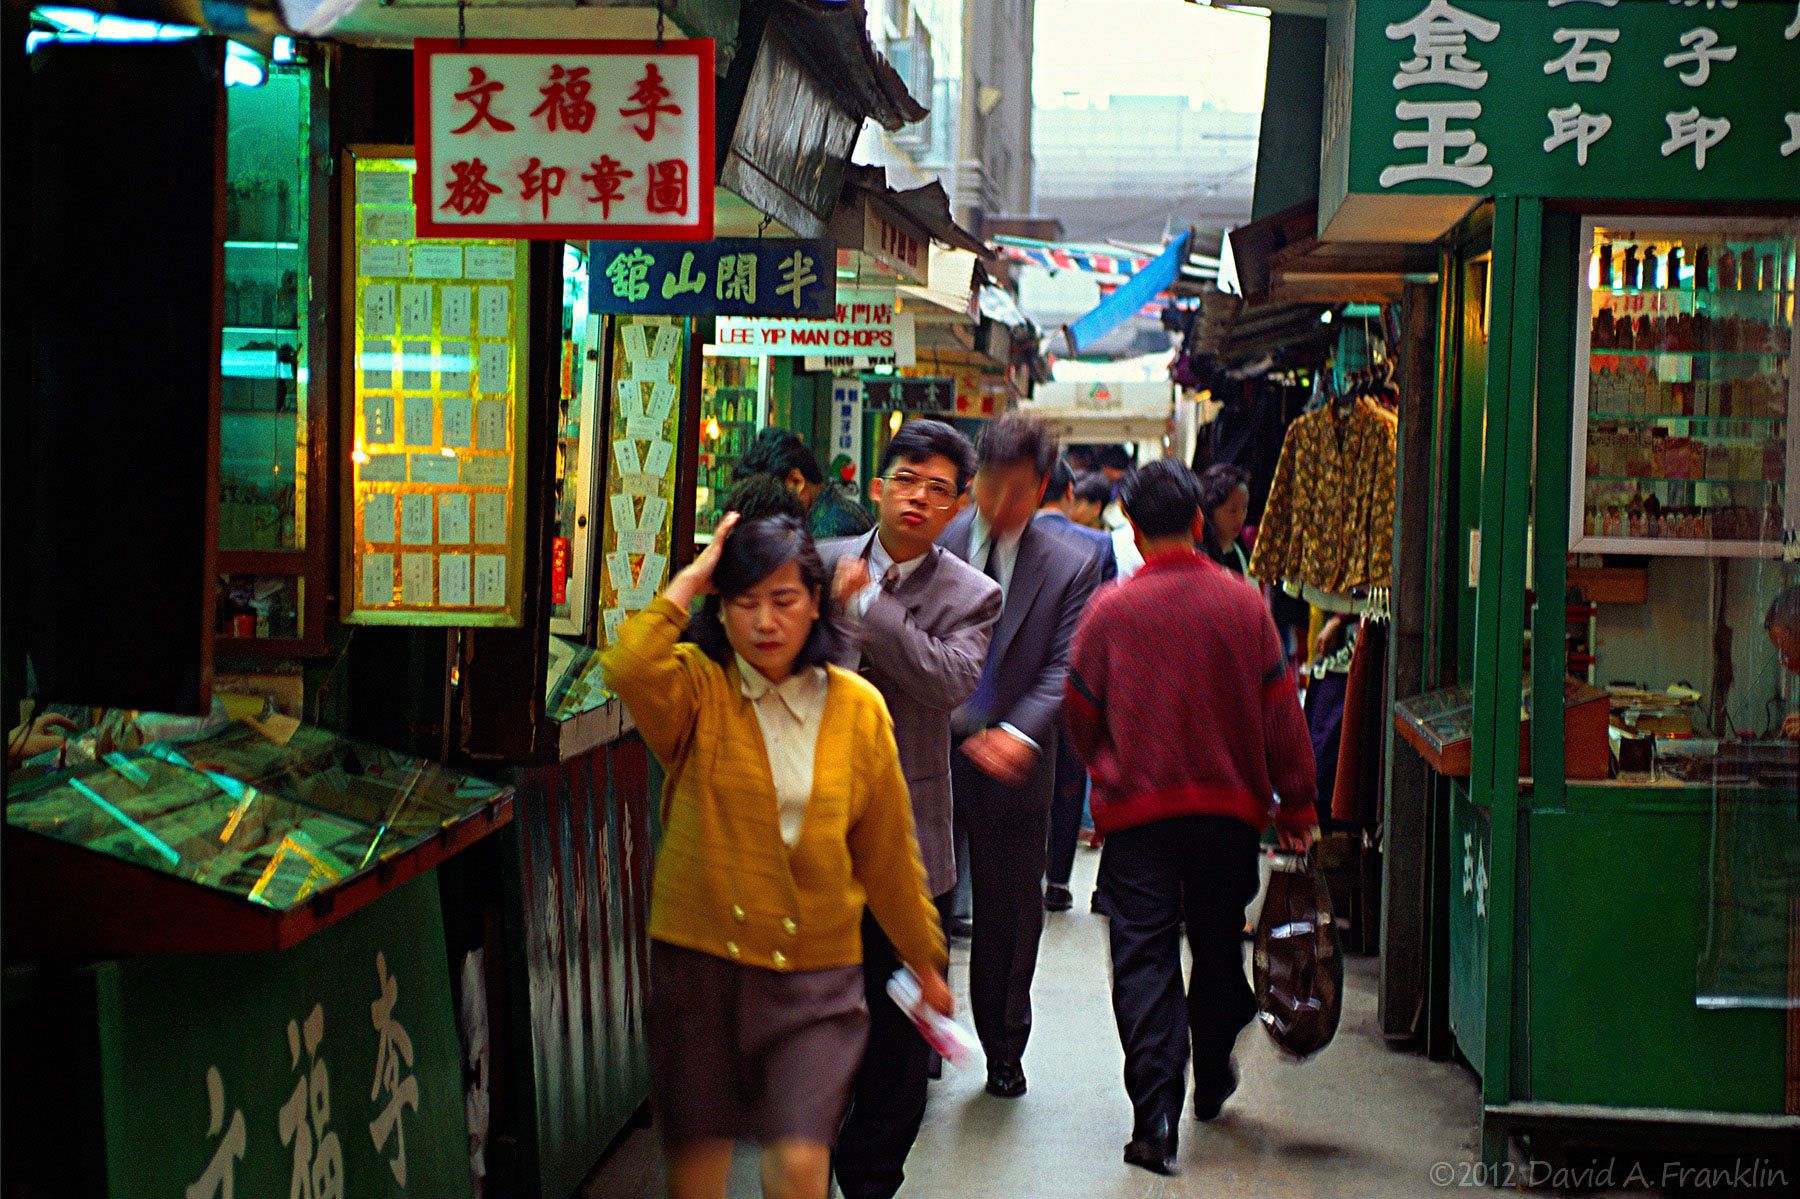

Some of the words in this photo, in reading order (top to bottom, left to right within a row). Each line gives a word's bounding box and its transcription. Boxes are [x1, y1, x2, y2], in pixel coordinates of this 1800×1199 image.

[449, 62, 682, 142] 李福文
[1379, 0, 1500, 188] 金玉
[1543, 0, 1620, 167] 石印
[1660, 0, 1738, 170] 子印
[439, 154, 689, 221] 圖章印務
[720, 328, 754, 345] LEE
[761, 328, 786, 345] YIP
[791, 329, 829, 346] MAN
[833, 329, 893, 347] CHOPS
